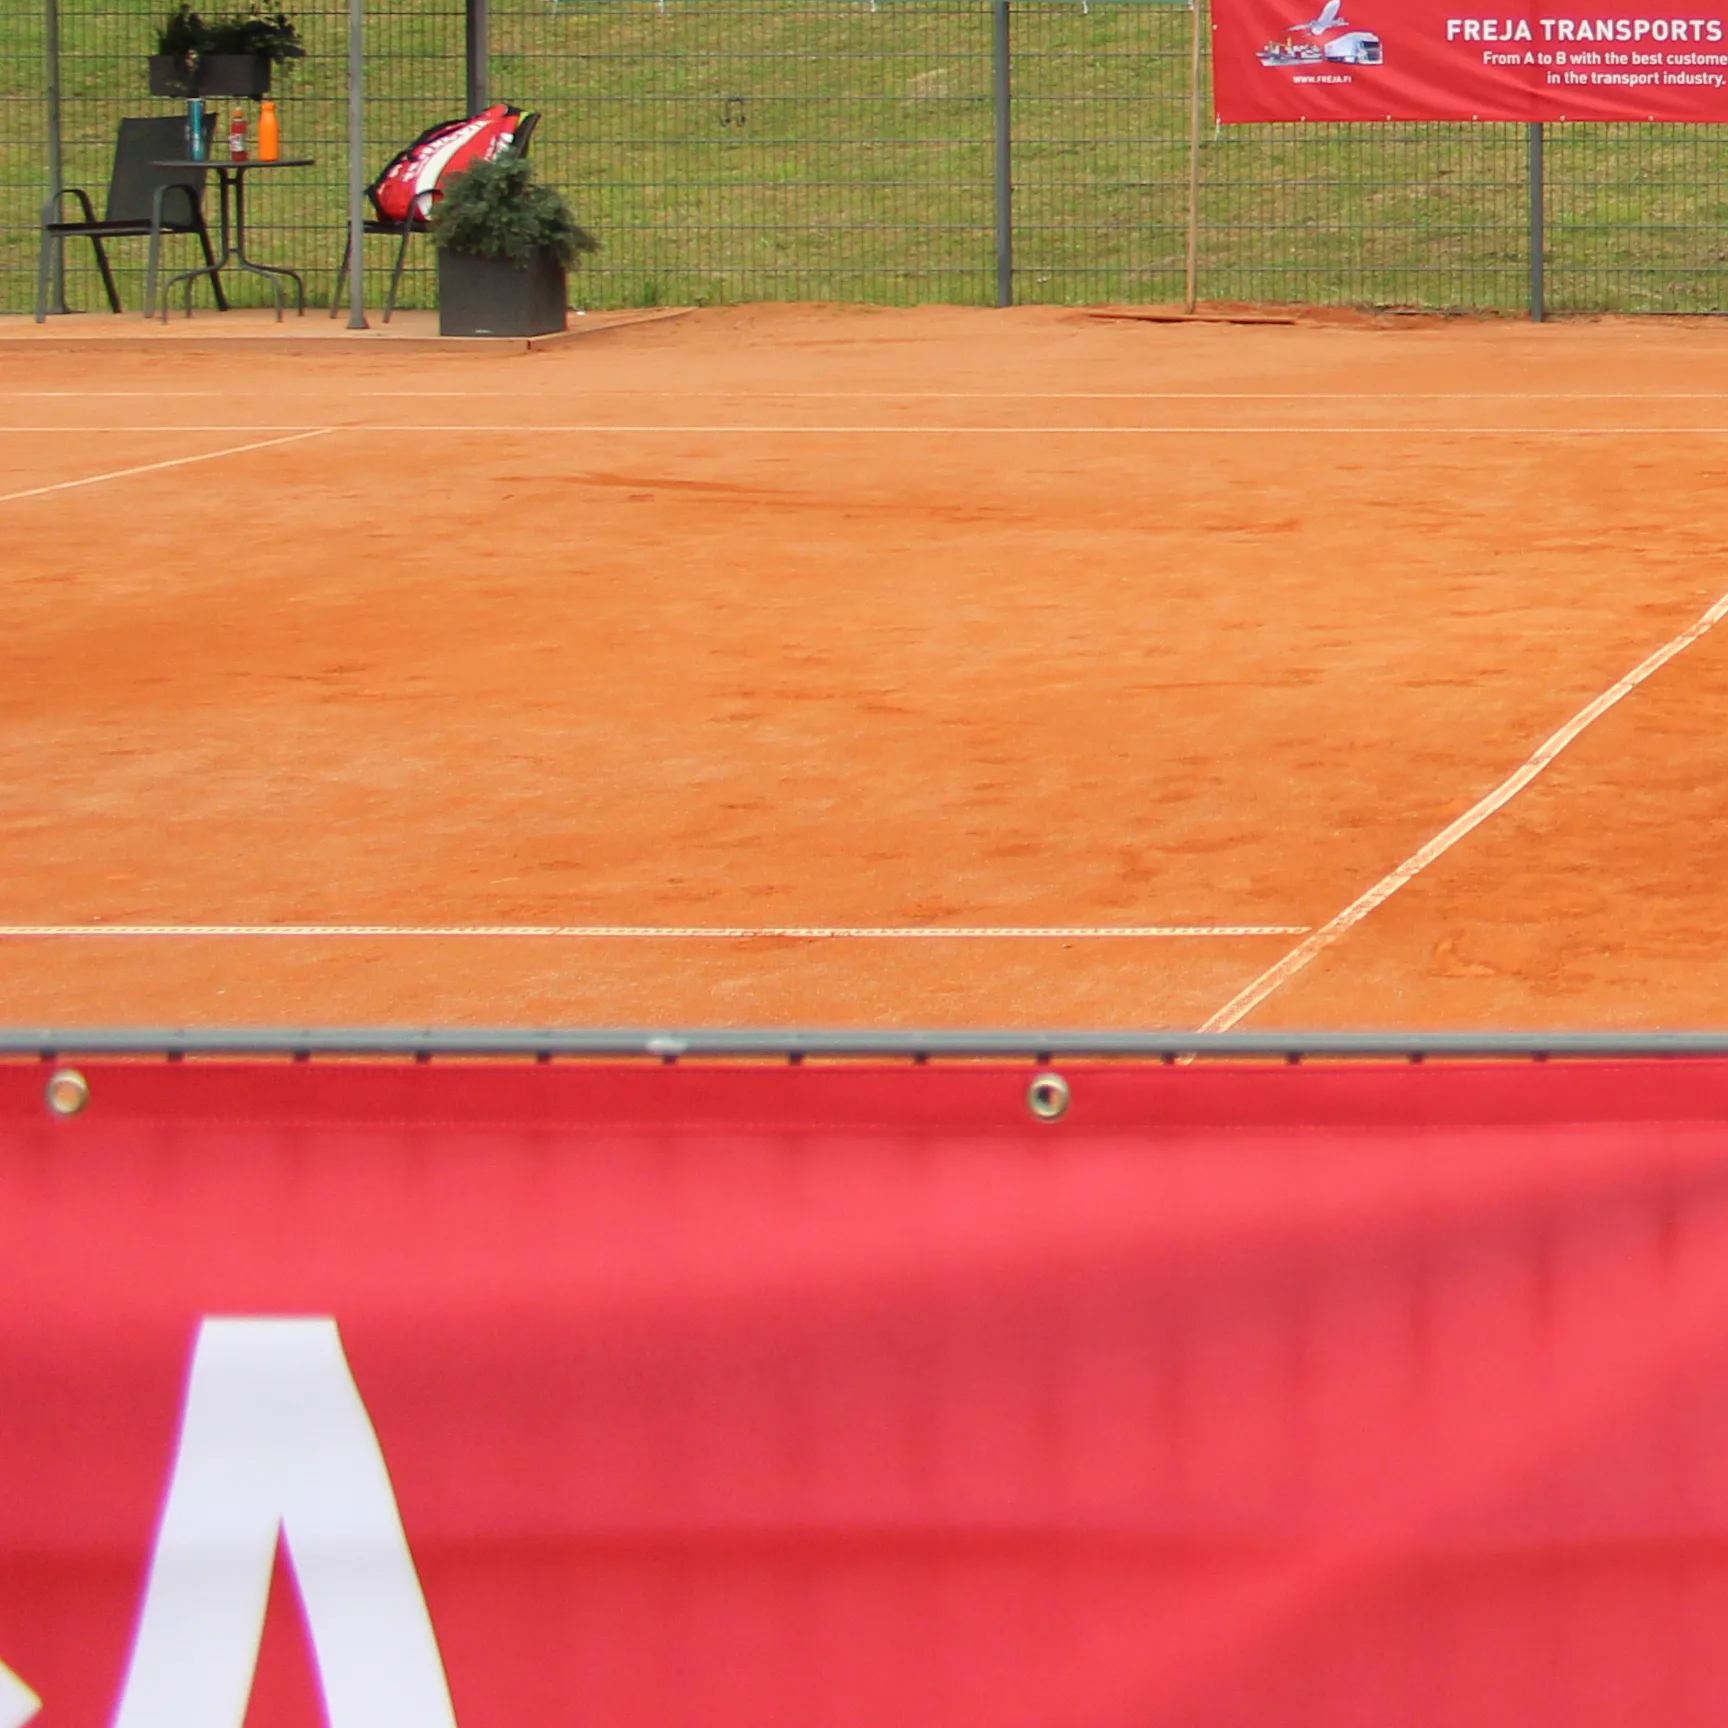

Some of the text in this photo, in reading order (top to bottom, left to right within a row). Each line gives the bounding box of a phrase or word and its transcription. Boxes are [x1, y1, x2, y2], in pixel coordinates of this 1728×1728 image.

[1447, 20, 1531, 40] FREJA
[1540, 20, 1722, 41] TRANSPORTS
[1484, 51, 1520, 64] From
[1524, 52, 1534, 64] A
[1538, 53, 1552, 64] to
[1556, 52, 1566, 64] B
[1570, 52, 1601, 64] with
[1605, 52, 1628, 64] the
[1632, 52, 1662, 64] best
[1548, 71, 1726, 87] in the transport industry.
